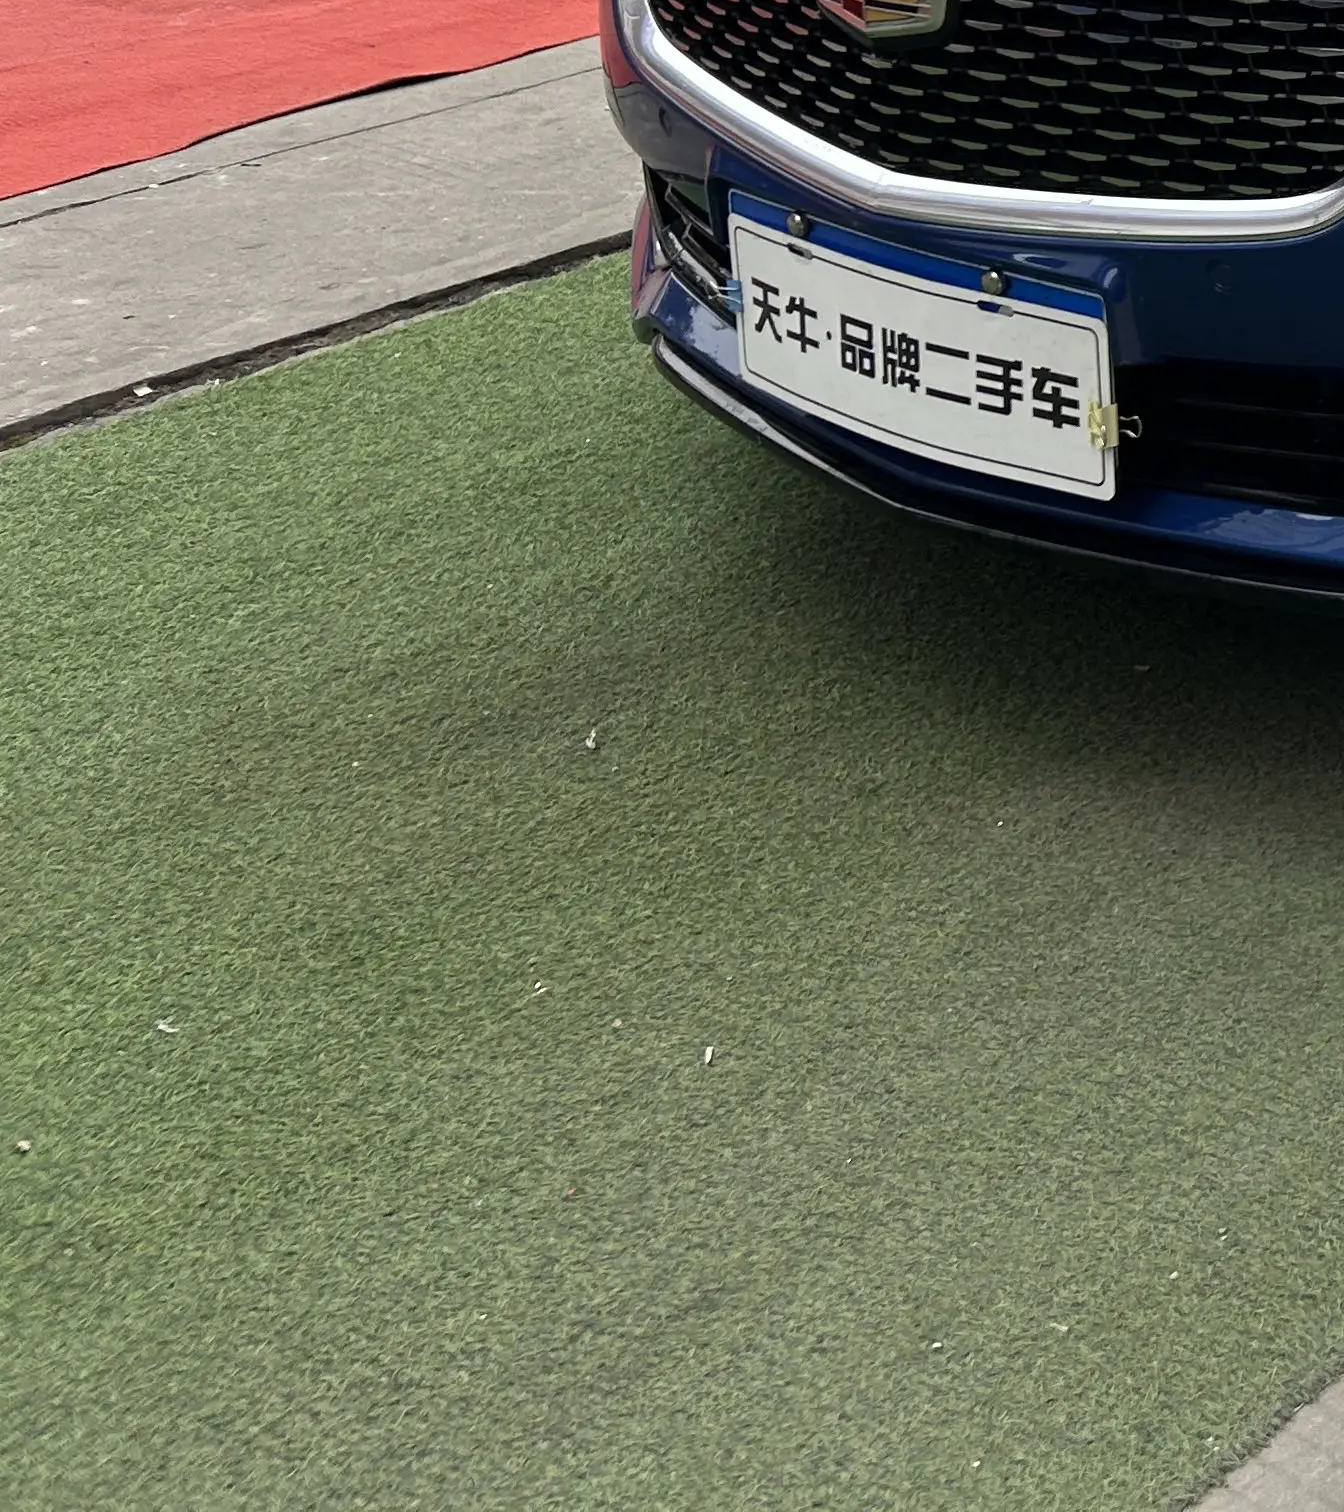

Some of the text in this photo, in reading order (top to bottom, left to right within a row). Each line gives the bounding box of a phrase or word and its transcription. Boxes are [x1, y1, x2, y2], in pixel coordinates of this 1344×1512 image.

[750, 276, 1081, 429] 天牛·品牌二手车
